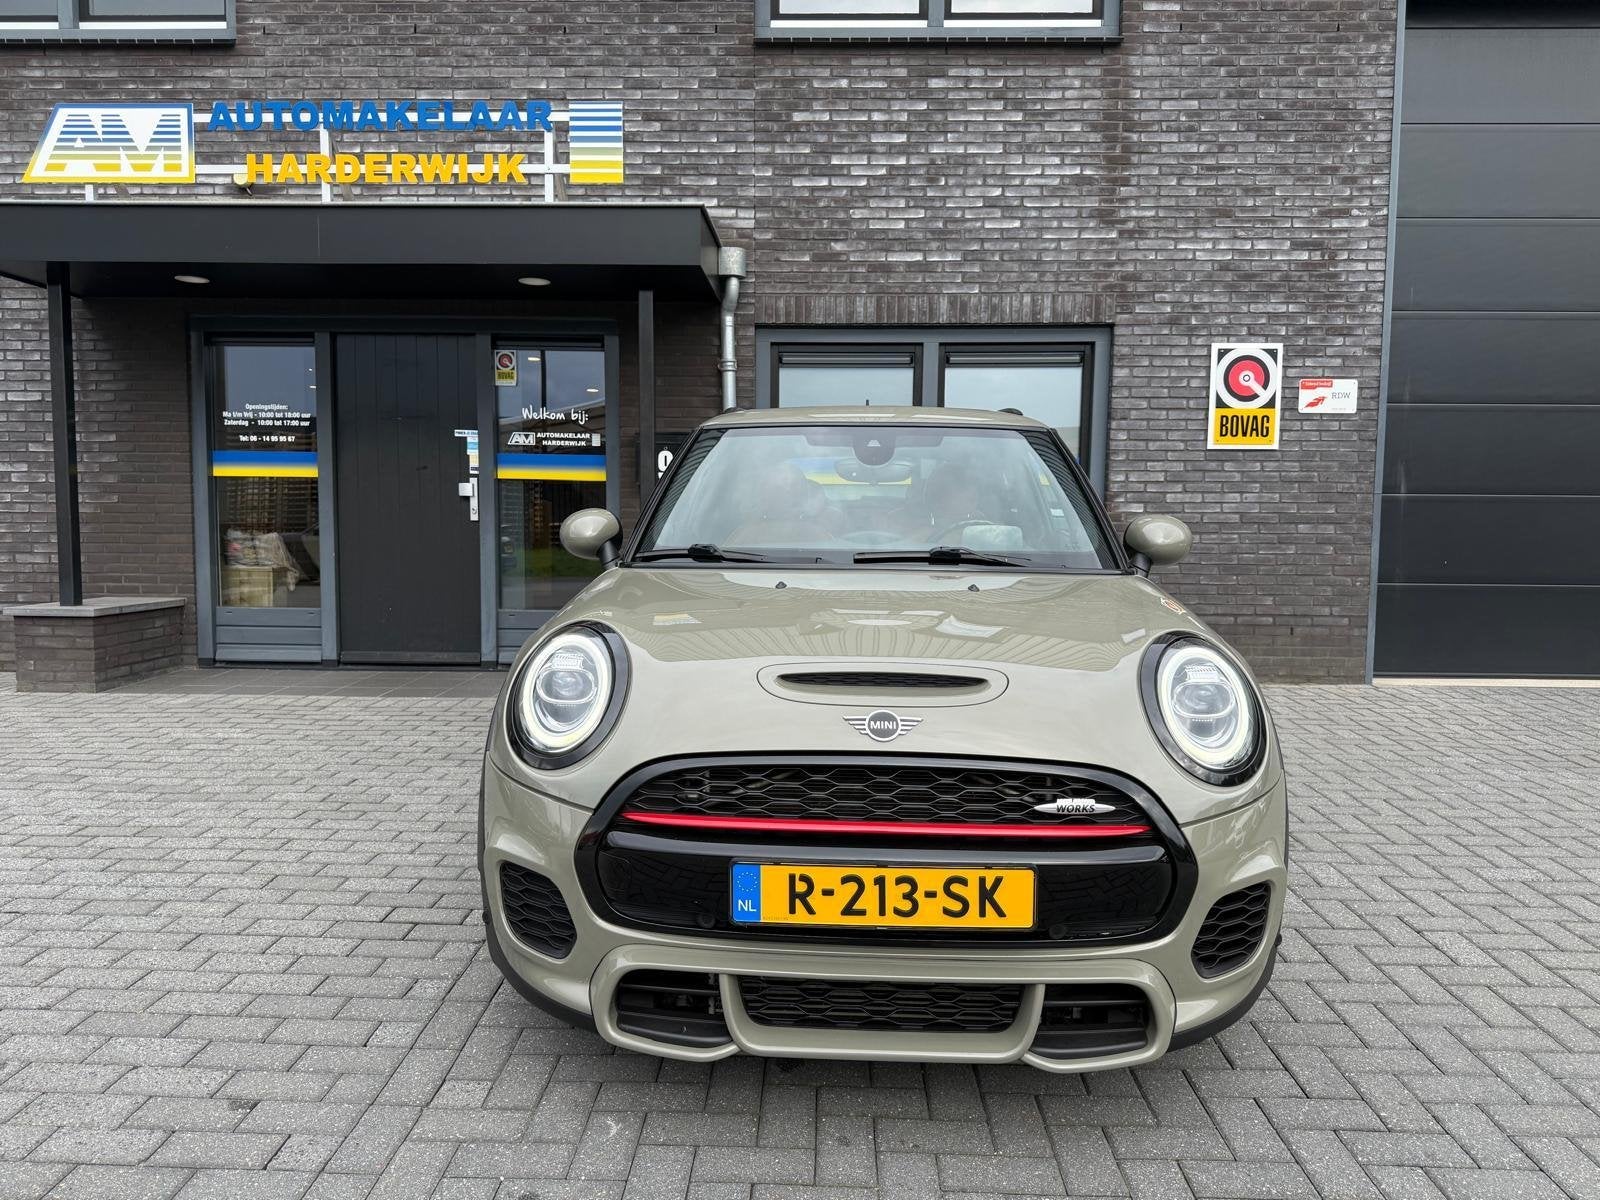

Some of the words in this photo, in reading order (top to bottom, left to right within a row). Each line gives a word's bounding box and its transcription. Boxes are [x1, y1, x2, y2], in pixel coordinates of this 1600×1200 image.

[207, 101, 554, 131] AUTOMAKELAAR
[45, 113, 182, 173] AM
[245, 153, 528, 185] HARDERWIJK
[1331, 391, 1351, 400] RDW
[522, 404, 566, 420] Welkom
[571, 408, 589, 425] bij:
[1219, 414, 1270, 438] BOVAG
[511, 432, 534, 444] AM
[870, 720, 897, 730] MINI
[1056, 804, 1095, 813] WORKS
[738, 899, 757, 913] NL
[787, 872, 1007, 919] R-213-SK
